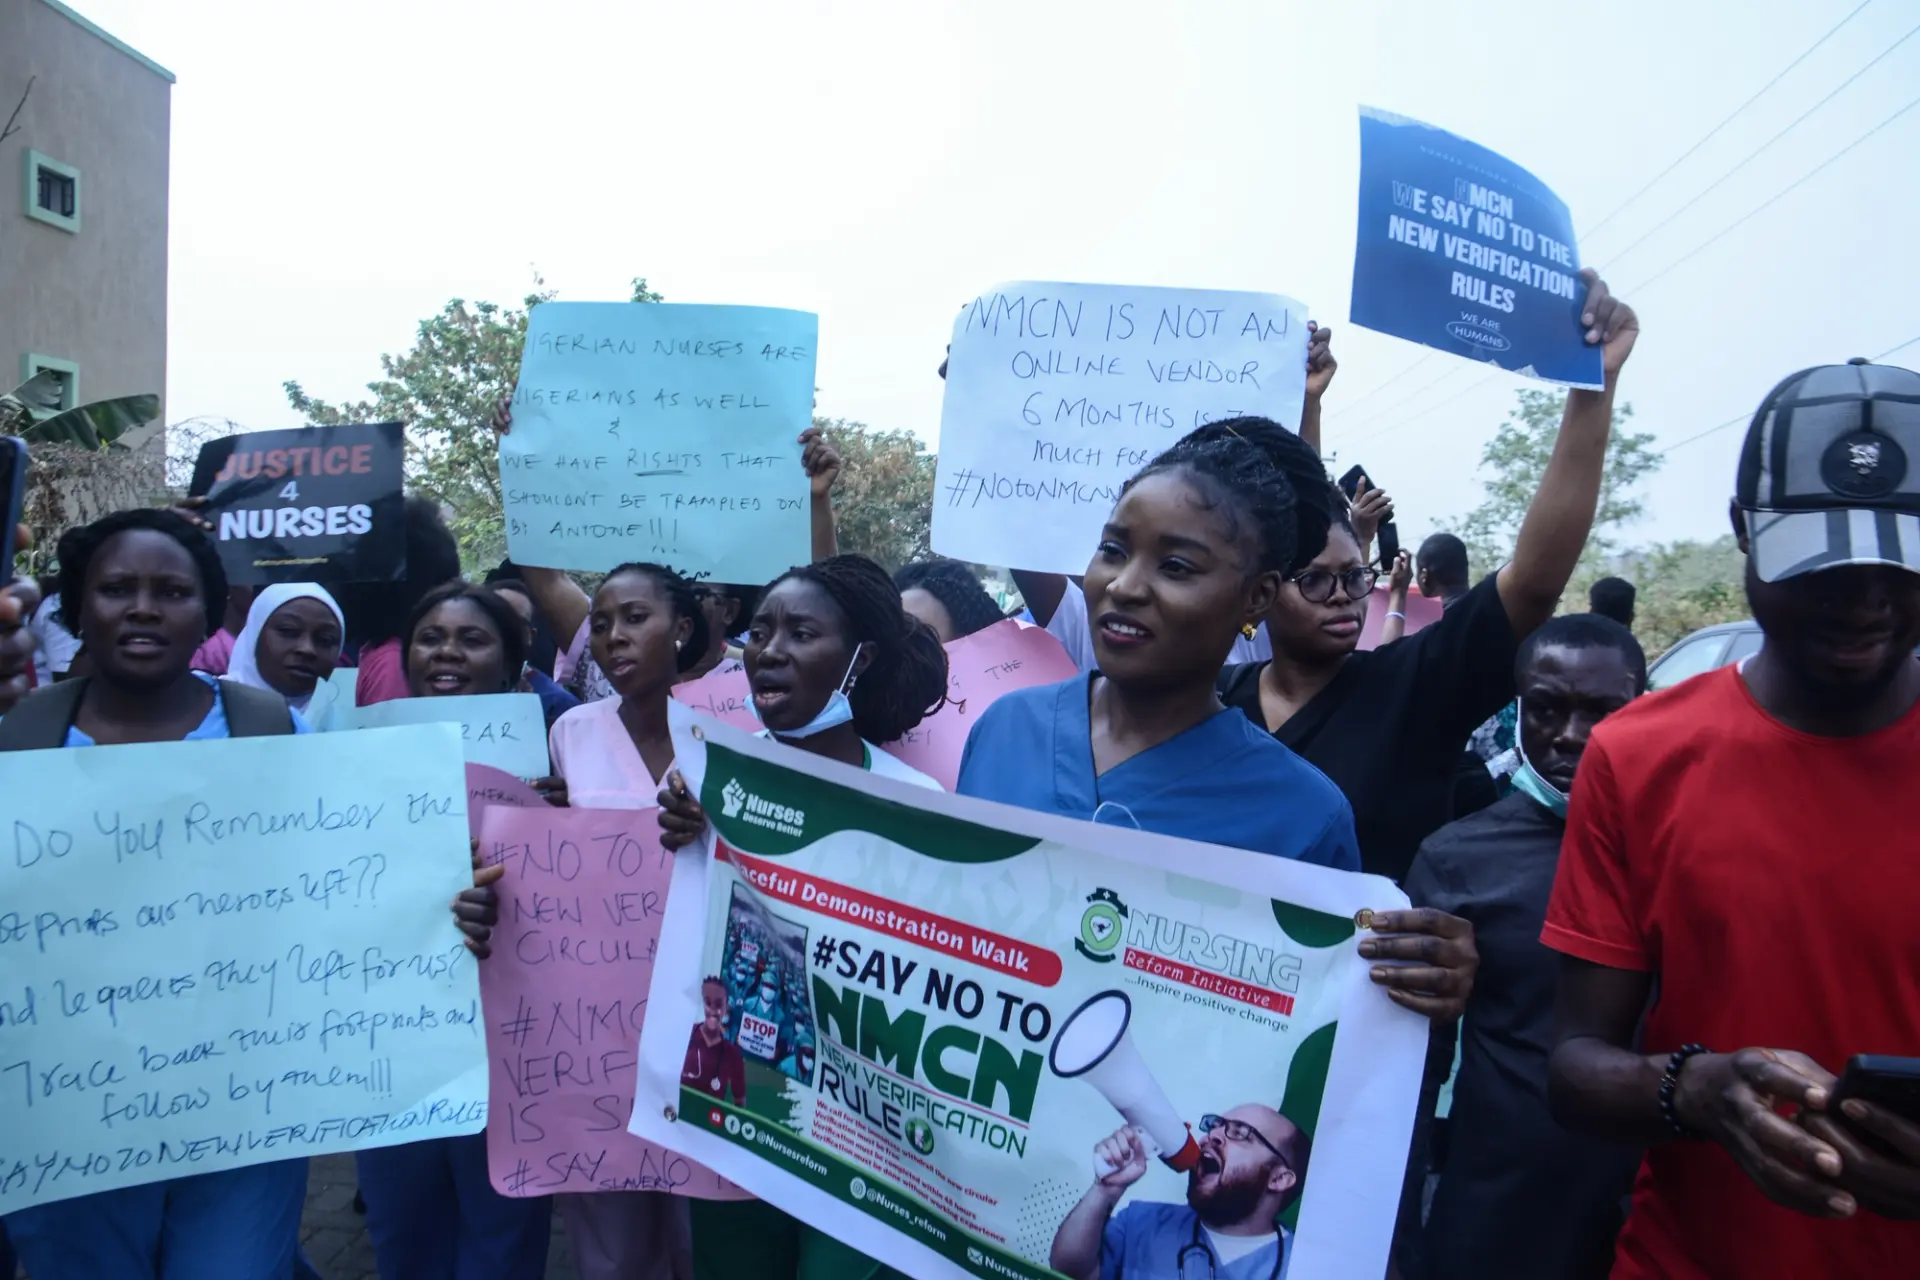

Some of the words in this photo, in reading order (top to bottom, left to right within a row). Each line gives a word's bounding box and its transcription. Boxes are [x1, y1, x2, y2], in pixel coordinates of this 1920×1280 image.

[1455, 177, 1513, 220] NMCN
[1393, 180, 1427, 214] WE
[1431, 195, 1471, 229] SAY
[1477, 213, 1504, 241] NO
[1510, 223, 1534, 252] TO
[1538, 234, 1573, 268] THE
[1388, 214, 1438, 253] NEW
[1444, 232, 1575, 300] VERIFICATION
[1451, 271, 1515, 313] RULES
[966, 293, 1082, 338] NMCN
[1106, 303, 1135, 341] IS
[1153, 304, 1225, 345] NOT
[1241, 308, 1288, 342] AN
[1454, 325, 1503, 348] HUMANS
[1461, 311, 1478, 324] WE
[1480, 315, 1501, 331] ARE
[531, 332, 636, 356] IGERIAN
[654, 339, 743, 357] NURSES
[761, 343, 809, 361] ARE
[1012, 351, 1126, 379] ONLINE
[1147, 360, 1261, 389] VENDOR
[654, 388, 679, 410] AS
[695, 393, 770, 410] WELL
[1022, 391, 1043, 426] 6
[1055, 397, 1175, 428] MONTHS
[215, 444, 373, 482] JUSTICE
[505, 455, 546, 470] WE
[554, 456, 608, 470] HAVE
[627, 448, 702, 470] RIGHTS
[721, 452, 785, 469] THAT
[1033, 439, 1101, 468] MUCH
[1116, 447, 1148, 466] FOR
[278, 480, 300, 501] 4
[620, 493, 647, 508] BE
[661, 493, 762, 510] TRAMPLED
[779, 496, 804, 511] ON
[945, 468, 1122, 508] #NOtoNMCNV
[219, 503, 373, 541] NURSES
[985, 659, 1023, 680] THE
[14, 820, 73, 868] Do
[94, 810, 163, 864] You
[185, 797, 385, 846] Remember
[407, 792, 465, 824] the
[742, 811, 776, 830] Deserve
[776, 821, 803, 838] Better
[746, 793, 805, 826] Nurses
[592, 831, 643, 879] TO
[514, 892, 583, 926] NEW
[603, 891, 664, 926] VER
[738, 862, 797, 898] aceful
[801, 884, 964, 951] Demonstration
[971, 935, 1029, 973] Walk
[516, 930, 657, 965] CIRCULA
[1126, 908, 1302, 994] NURSING
[0, 986, 38, 1026] nd
[287, 944, 356, 996] left
[362, 947, 404, 993] for
[812, 934, 918, 996] #SAY
[922, 967, 984, 1020] NO
[996, 990, 1051, 1042] TO
[1125, 952, 1184, 983] Reform
[1189, 971, 1272, 1008] Initiative
[500, 996, 648, 1049] #NMC
[744, 1017, 776, 1039] STOP
[1184, 990, 1236, 1016] positive
[1239, 1008, 1289, 1034] change
[139, 1040, 226, 1072] back
[445, 999, 478, 1037] and
[812, 972, 1044, 1123] NMCN
[503, 1050, 637, 1098] VERIF
[101, 1087, 209, 1129] follow
[228, 1072, 273, 1115] by
[818, 1062, 903, 1141] RULE
[820, 1037, 857, 1076] NEW
[863, 1067, 1027, 1159] VERIFICATION
[508, 1102, 545, 1144] IS
[503, 1149, 606, 1196] #SAY
[640, 1148, 691, 1187] NO
[756, 1130, 828, 1176] @Nursesreform
[866, 1187, 947, 1242] @Nurses_reform
